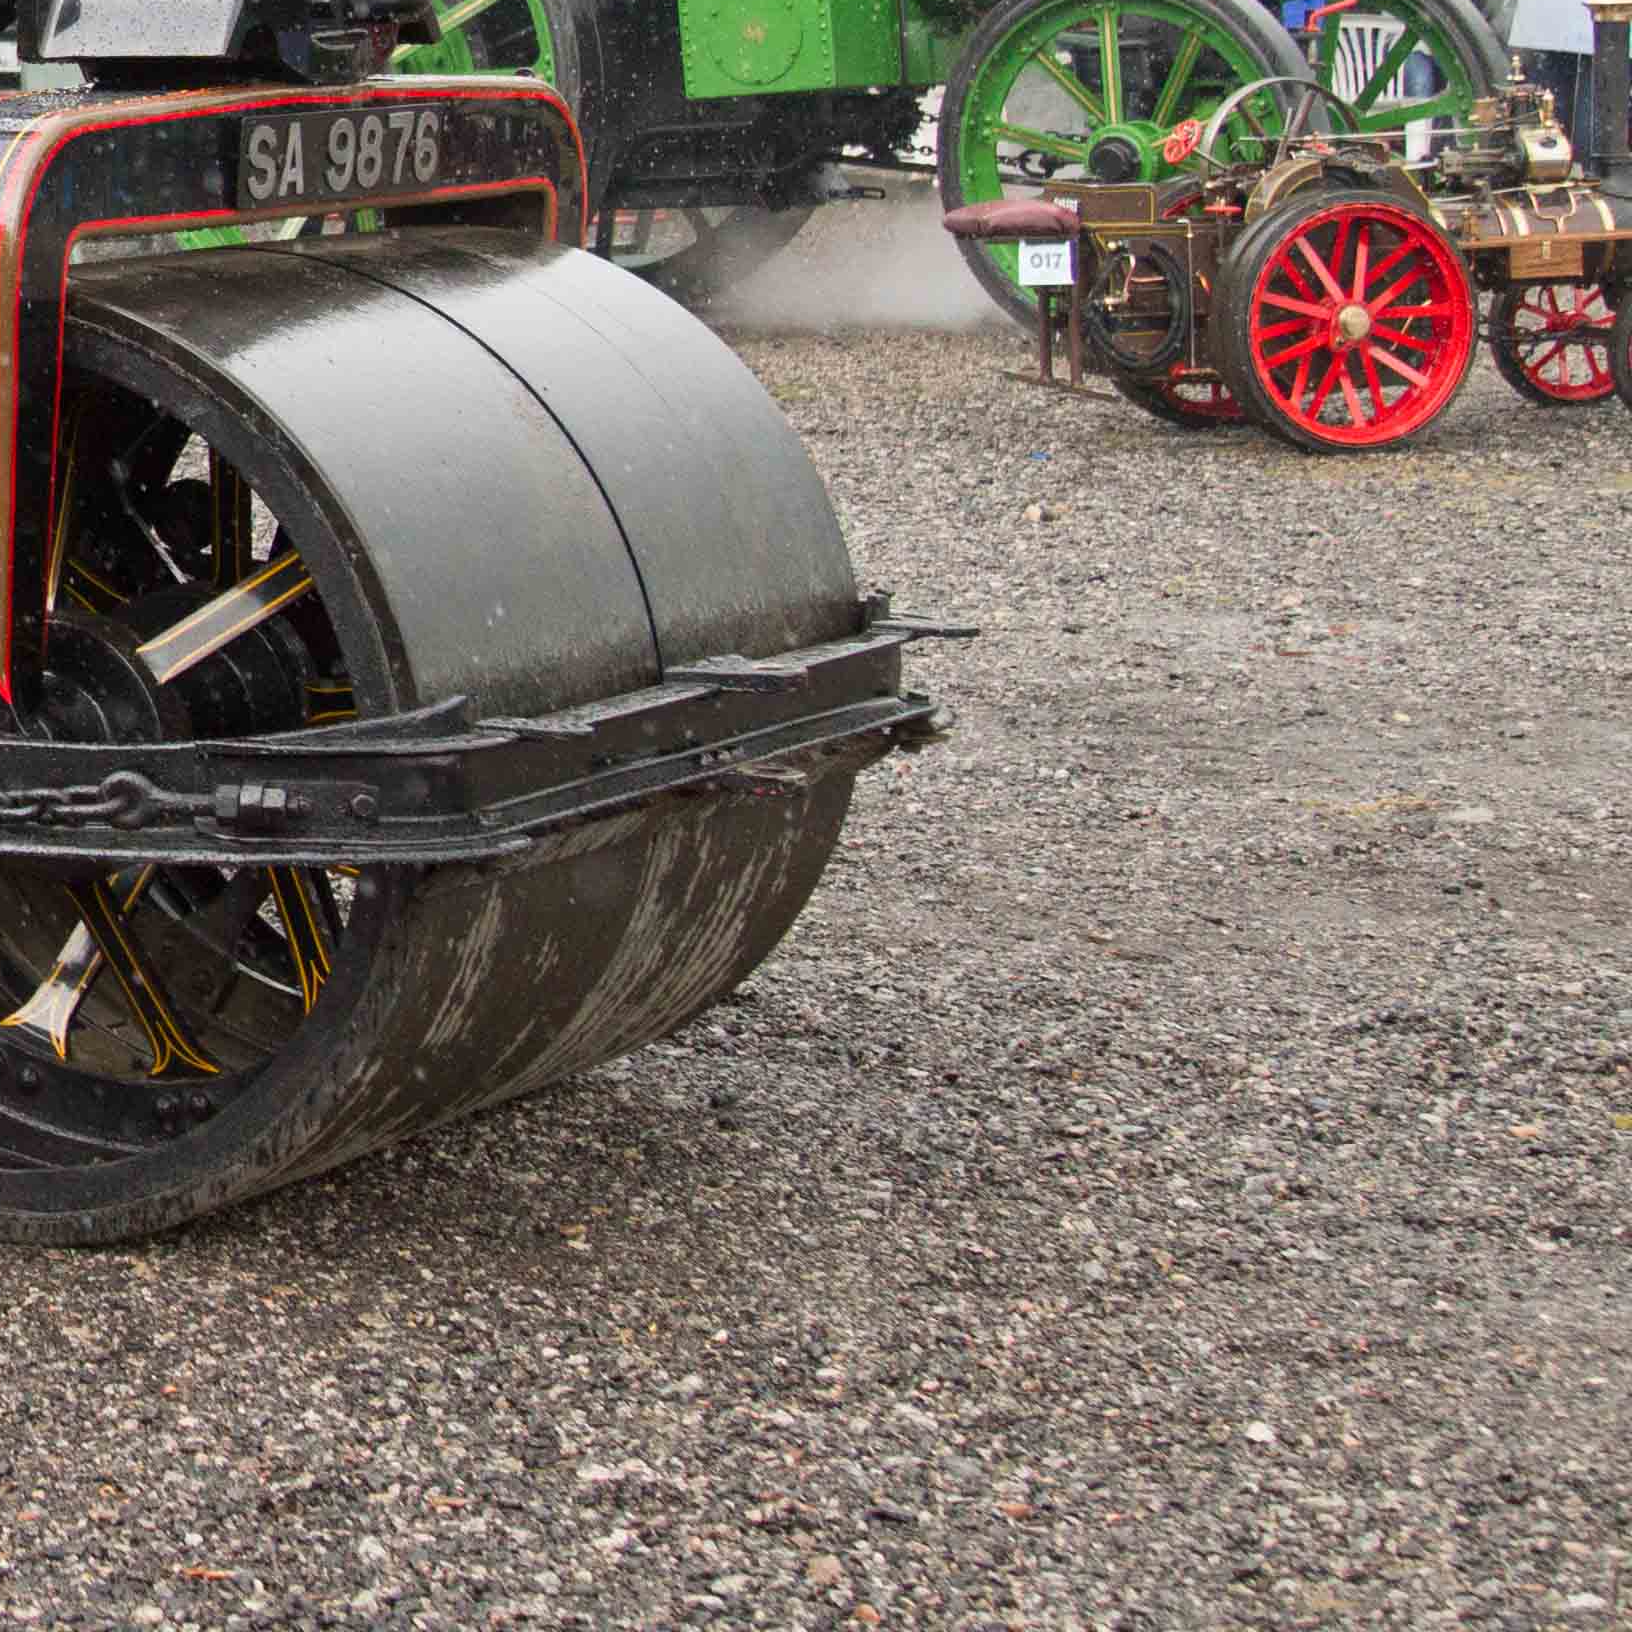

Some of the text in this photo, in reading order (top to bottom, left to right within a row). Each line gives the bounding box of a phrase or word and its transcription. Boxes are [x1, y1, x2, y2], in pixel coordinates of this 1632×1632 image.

[246, 111, 439, 200] SA 9876
[1029, 252, 1063, 269] 017
